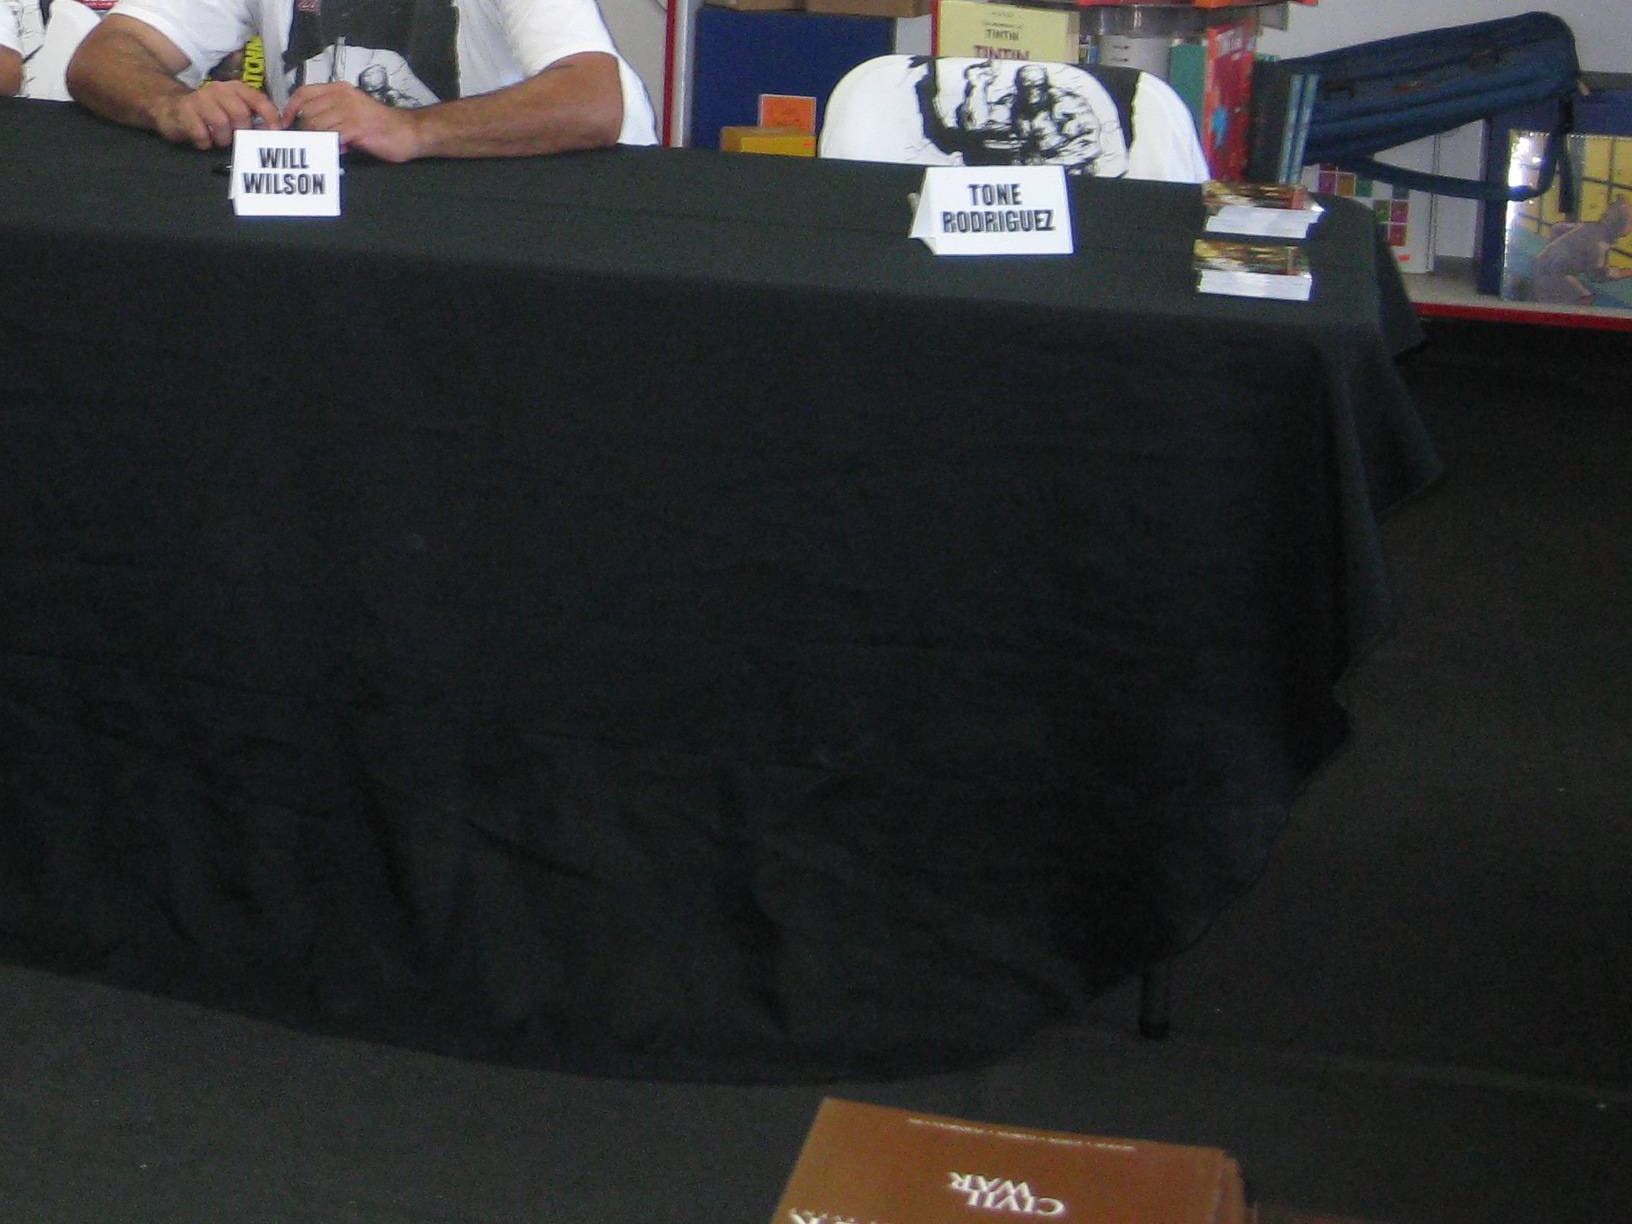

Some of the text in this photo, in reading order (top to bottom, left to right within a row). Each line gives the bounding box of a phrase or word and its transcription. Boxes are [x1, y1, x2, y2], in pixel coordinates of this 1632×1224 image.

[258, 147, 310, 170] WILL
[243, 173, 326, 196] WILSON
[967, 183, 1023, 206] TONE
[942, 210, 1056, 233] RODRIGUEZ
[947, 1172, 1035, 1198] WAR
[967, 1190, 1066, 1217] CIVIL
